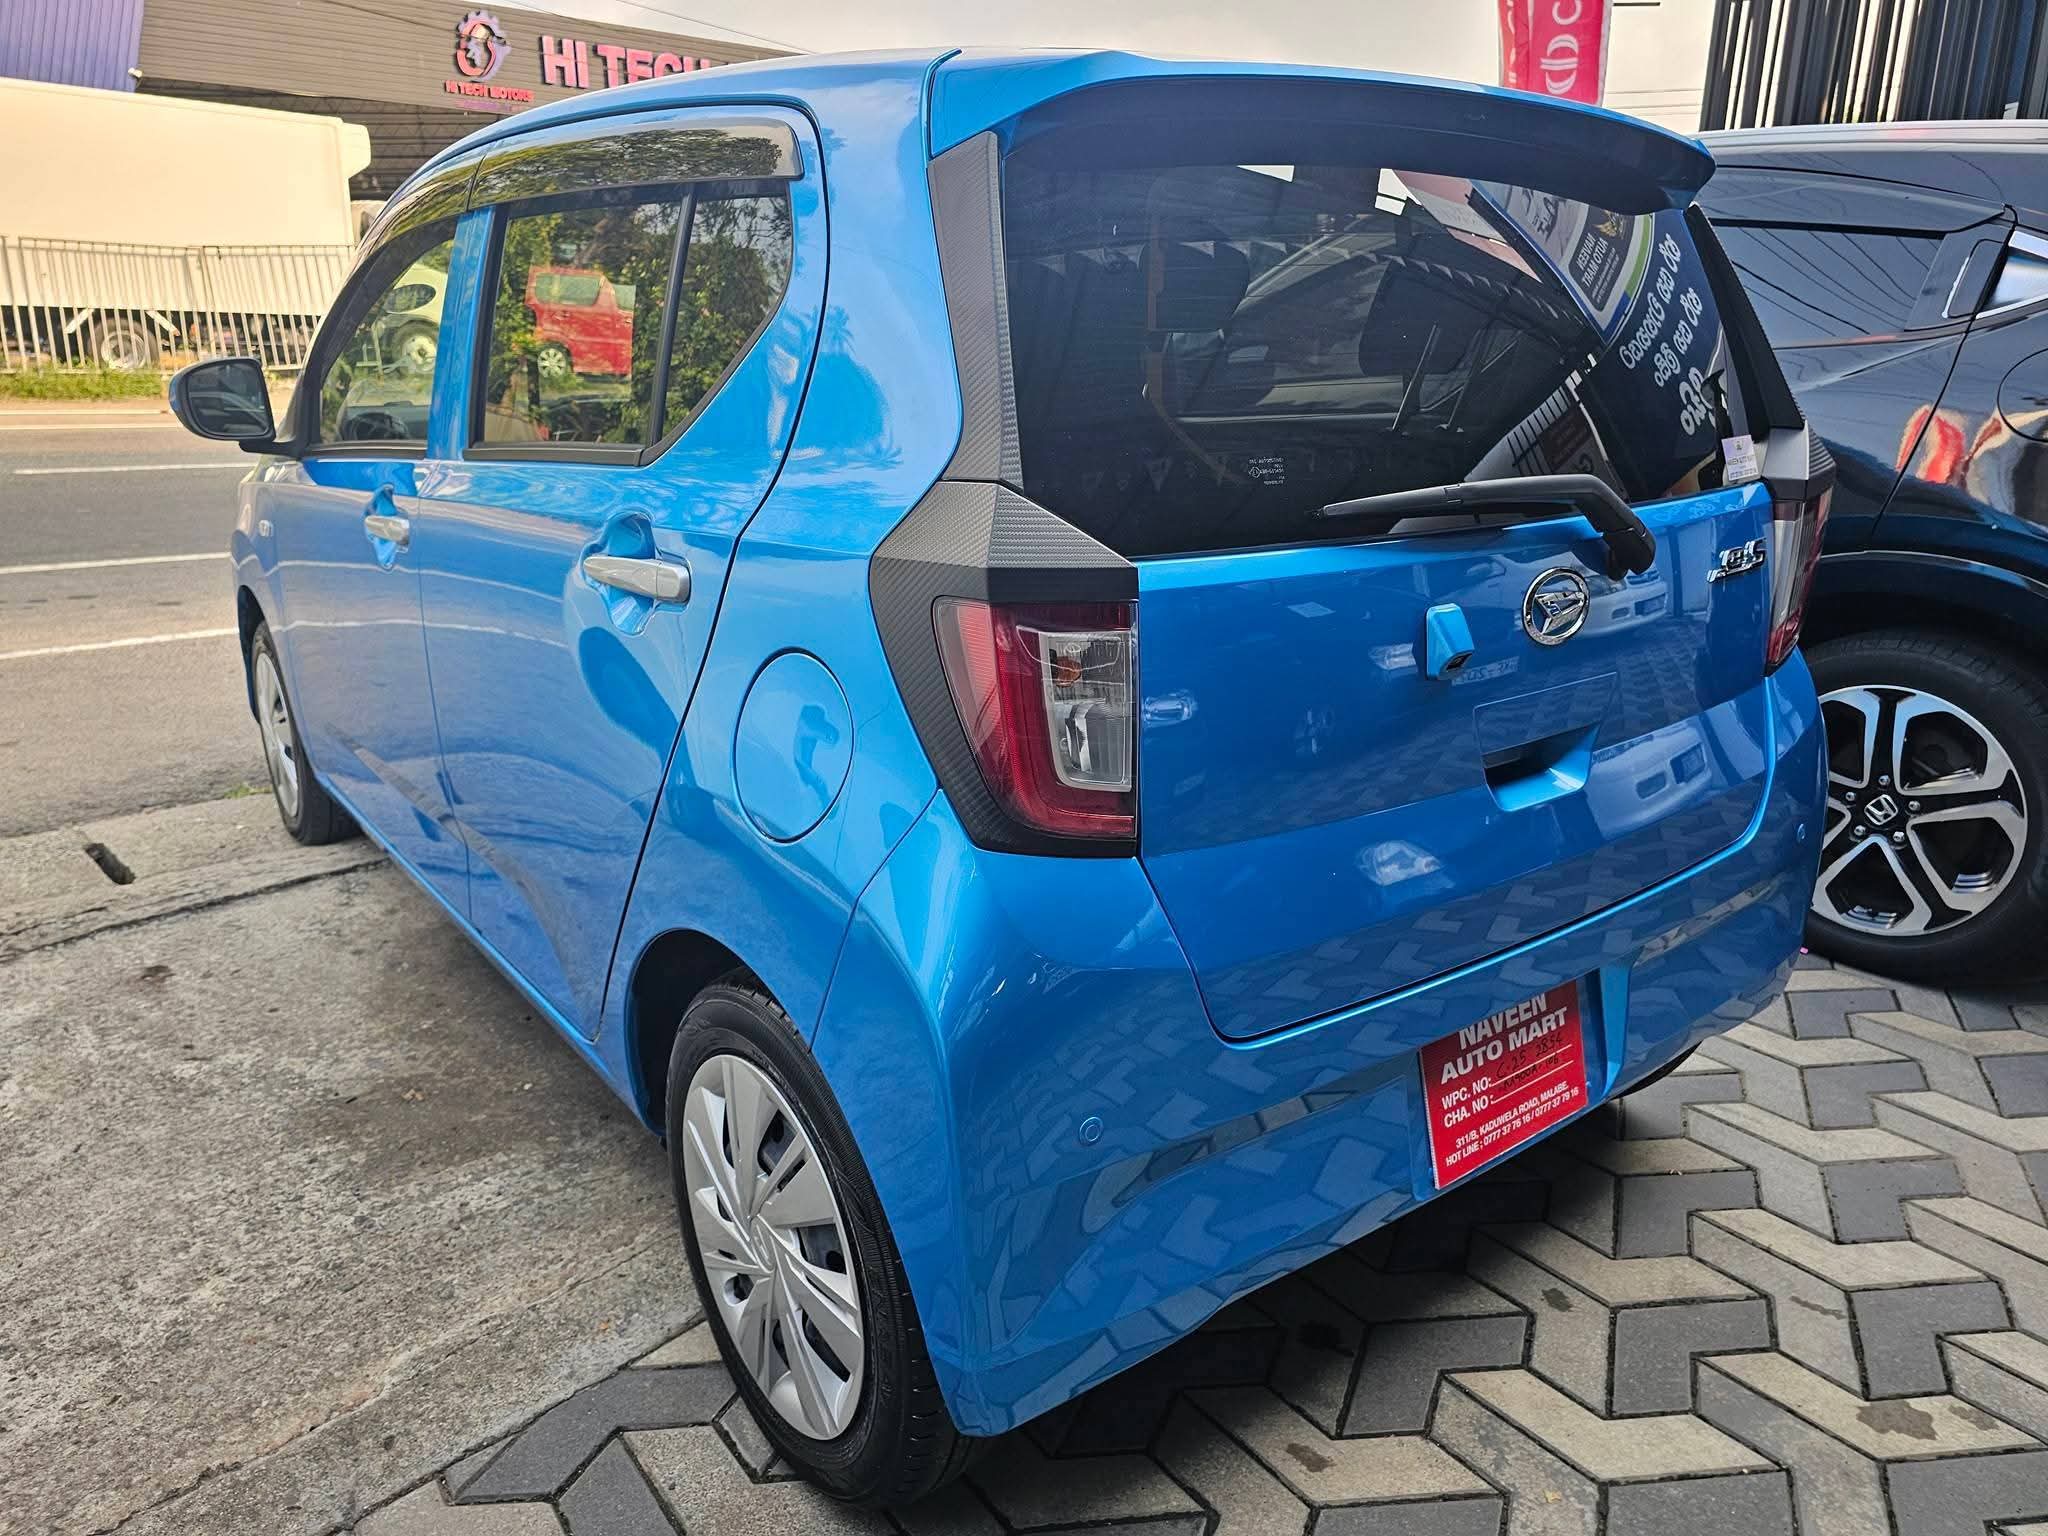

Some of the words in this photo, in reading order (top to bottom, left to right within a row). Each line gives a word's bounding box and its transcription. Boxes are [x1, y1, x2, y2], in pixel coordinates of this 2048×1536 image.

[539, 34, 589, 88] HI
[459, 82, 488, 98] TECH
[488, 86, 535, 103] MOTORS
[1458, 993, 1547, 1050] NAVEEN
[1441, 1039, 1503, 1085] AUTO
[1508, 1006, 1567, 1052] MART
[1441, 1087, 1471, 1110] WPC.
[1472, 1077, 1492, 1095] NO:
[1443, 1106, 1471, 1128] CHA.
[1471, 1094, 1489, 1114] NO
[1480, 1107, 1519, 1136] KADUWELA
[1518, 1097, 1540, 1116] ROAD,
[1446, 1152, 1462, 1167] HOT
[1462, 1141, 1479, 1158] LINE
[1483, 1130, 1501, 1146] 0777
[1502, 1125, 1512, 1137] 37
